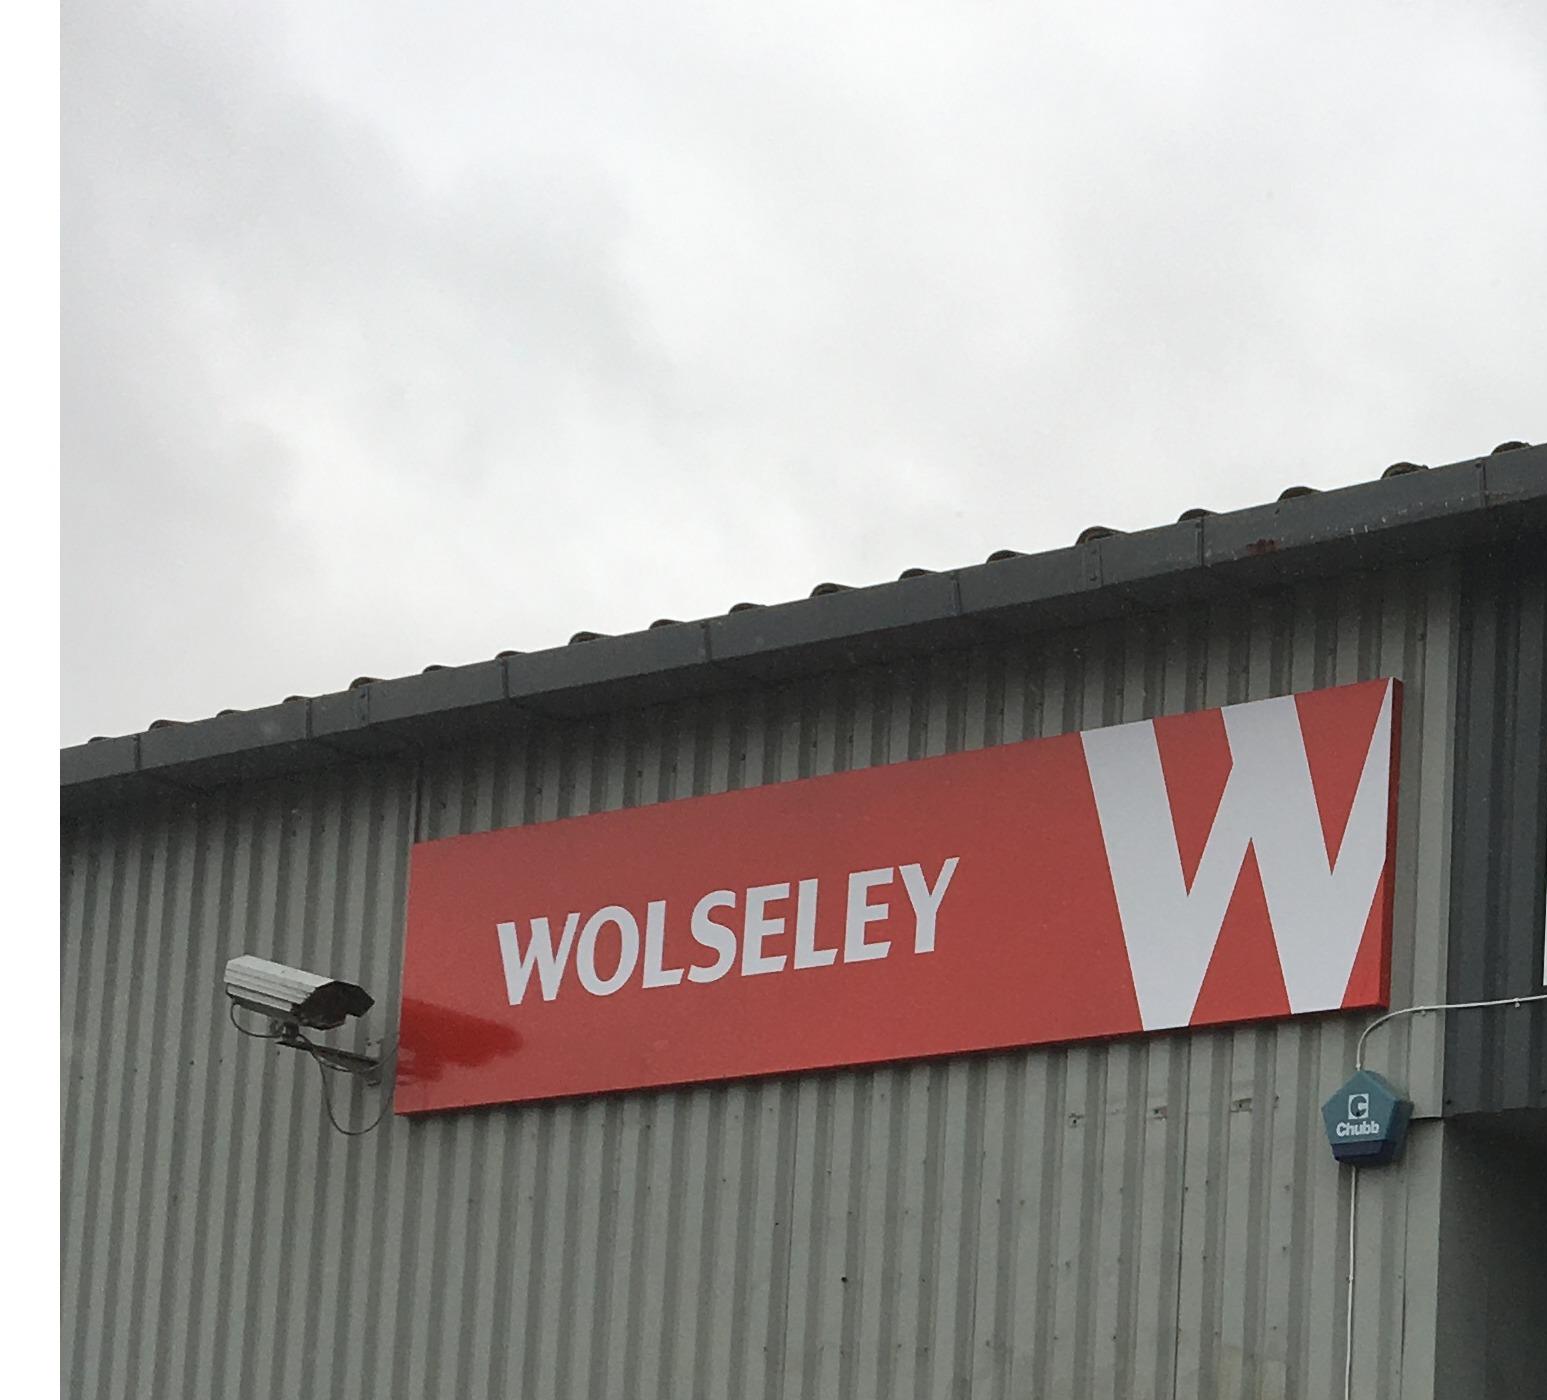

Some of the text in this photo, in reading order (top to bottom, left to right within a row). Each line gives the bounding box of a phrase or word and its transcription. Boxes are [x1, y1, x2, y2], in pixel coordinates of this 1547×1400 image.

[1080, 677, 1394, 1032] W
[496, 856, 960, 1006] WOLSELEY
[1336, 1121, 1380, 1137] Chubb
